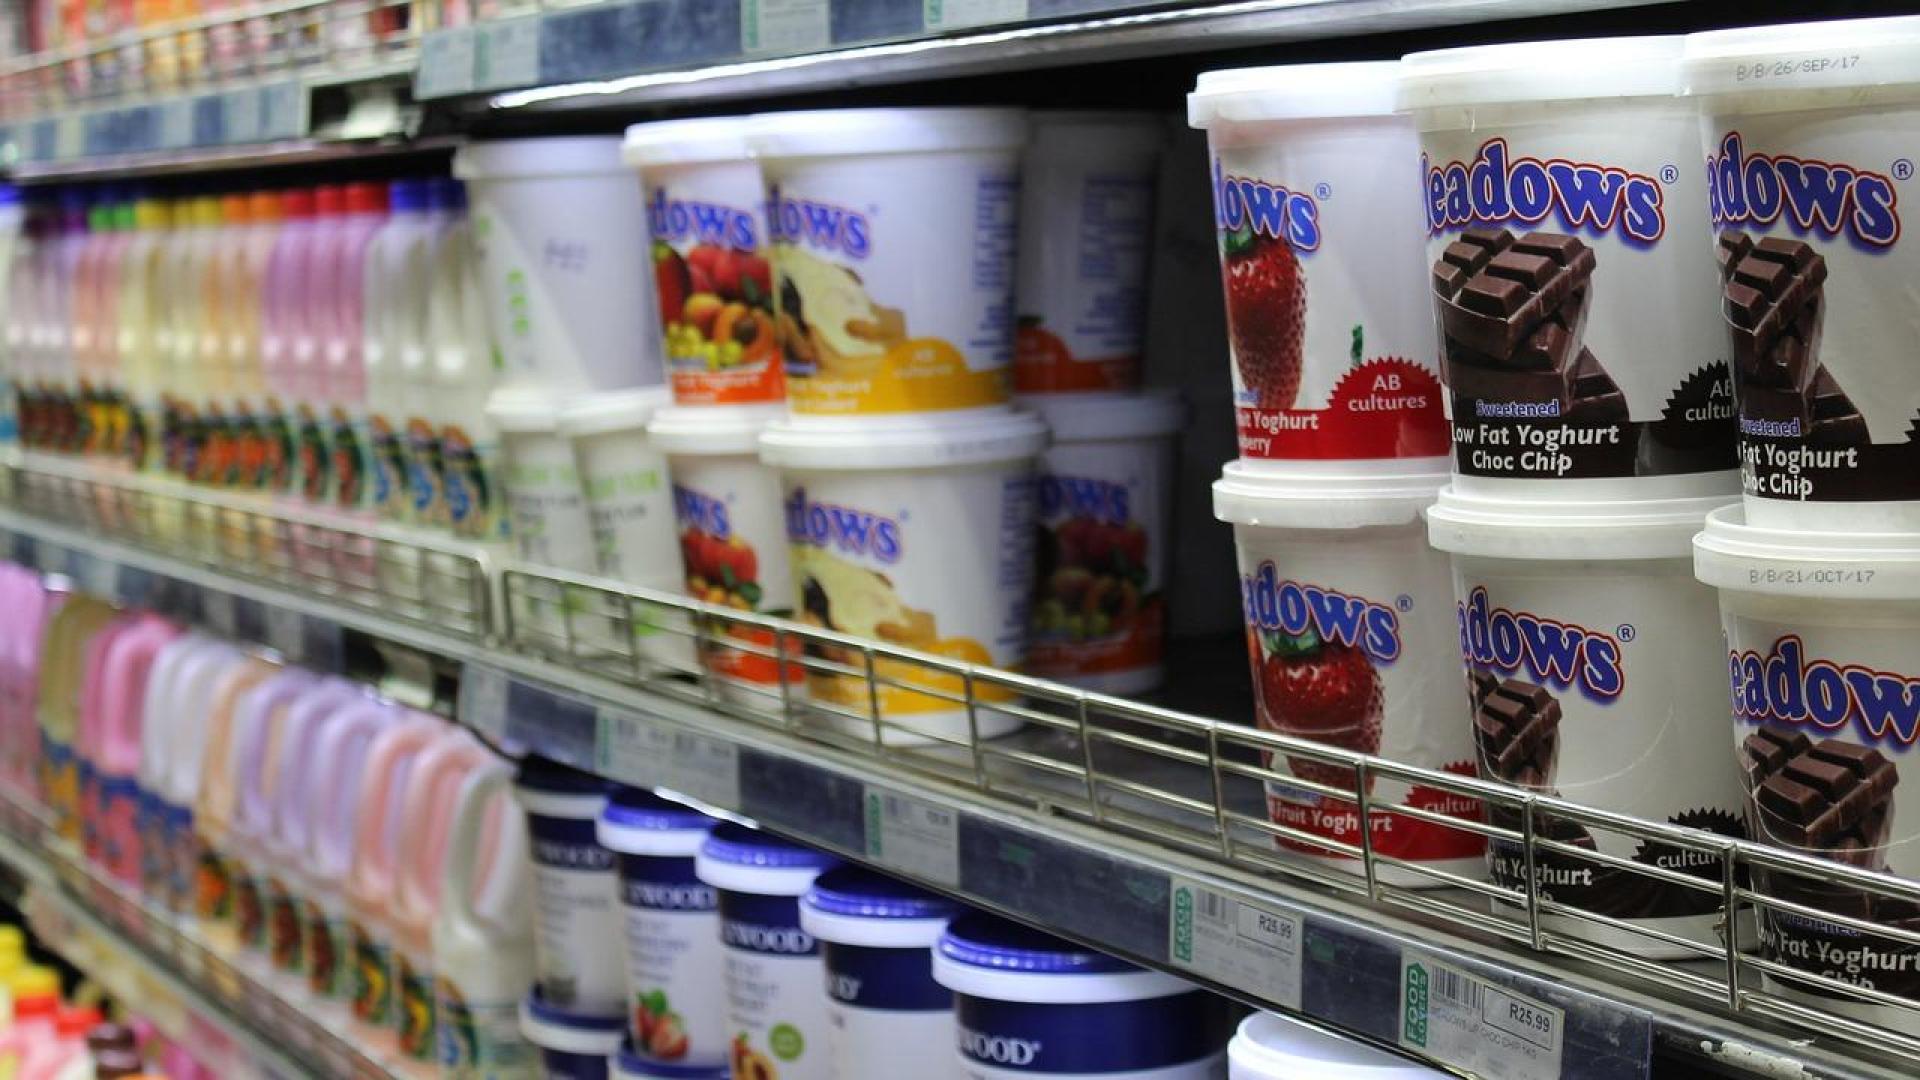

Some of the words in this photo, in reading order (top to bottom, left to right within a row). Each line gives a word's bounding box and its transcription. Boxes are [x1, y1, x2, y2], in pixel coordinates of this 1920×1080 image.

[1736, 56, 1861, 81] B/B/26/SEP/17
[1372, 374, 1401, 391] AB
[1348, 394, 1426, 412] cultures
[1476, 399, 1560, 418] Sweetened
[1254, 411, 1319, 434] Yoghurt
[1479, 424, 1509, 445] Fat
[1517, 424, 1620, 450] Yoghurt
[1472, 451, 1514, 471] Choc
[1520, 451, 1573, 476] Chip
[1764, 443, 1858, 474] Yoghurt
[1769, 473, 1813, 501] Chip
[1749, 570, 1875, 583] B/B/21/OCT/17
[1780, 931, 1809, 958] Fat
[1407, 968, 1418, 1040] FOOD
[1509, 1003, 1550, 1032] R25.99
